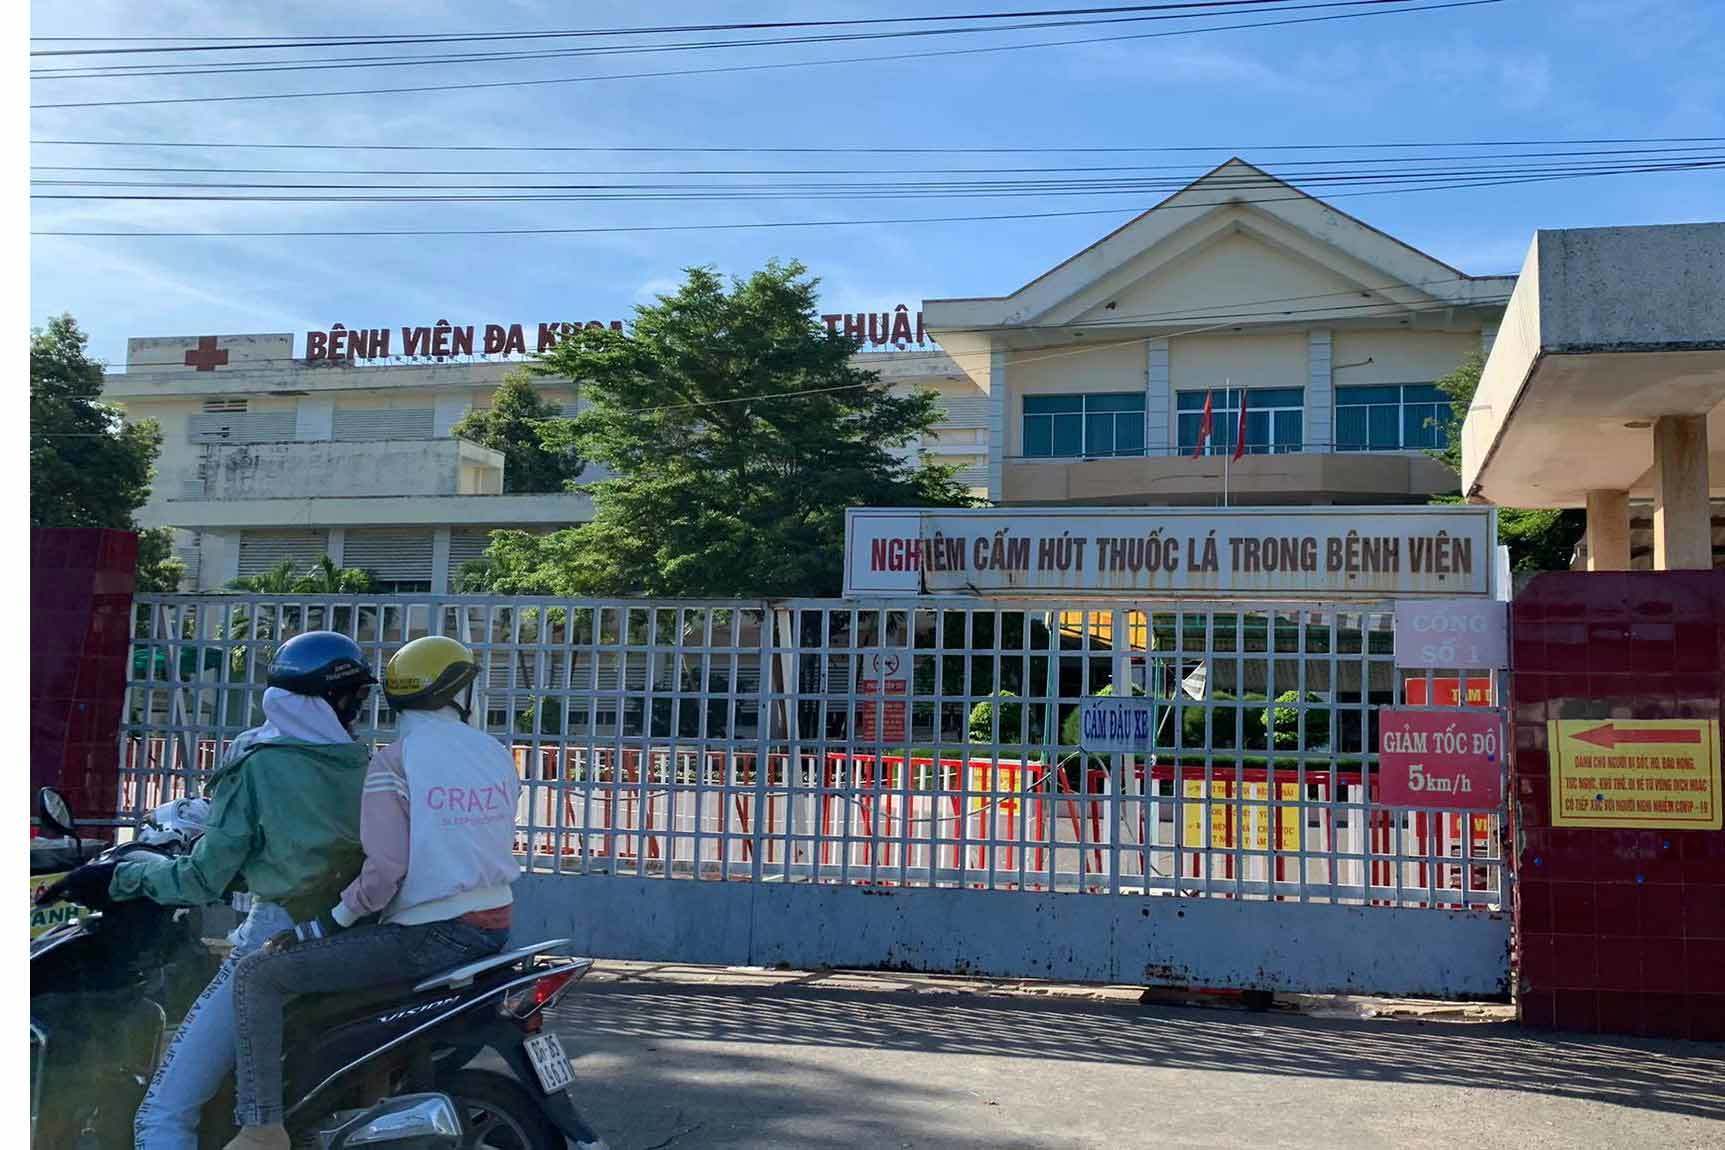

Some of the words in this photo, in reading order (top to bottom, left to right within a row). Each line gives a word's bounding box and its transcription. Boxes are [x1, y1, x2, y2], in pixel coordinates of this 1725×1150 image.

[484, 323, 527, 355] ĐA
[871, 531, 966, 572] NGHIÊM
[973, 527, 1031, 572] CẤM
[1038, 530, 1088, 572] HÚT
[1096, 527, 1179, 573] THUỐC
[1187, 529, 1219, 573] LÁ
[1229, 537, 1318, 573] TRONG
[1327, 530, 1400, 581] BỆNH
[1408, 530, 1472, 581] VIỆN
[1134, 710, 1149, 739] XE
[1384, 723, 1428, 753] GIẢM
[1433, 723, 1467, 754] TỐC
[427, 782, 511, 813] CRAZY
